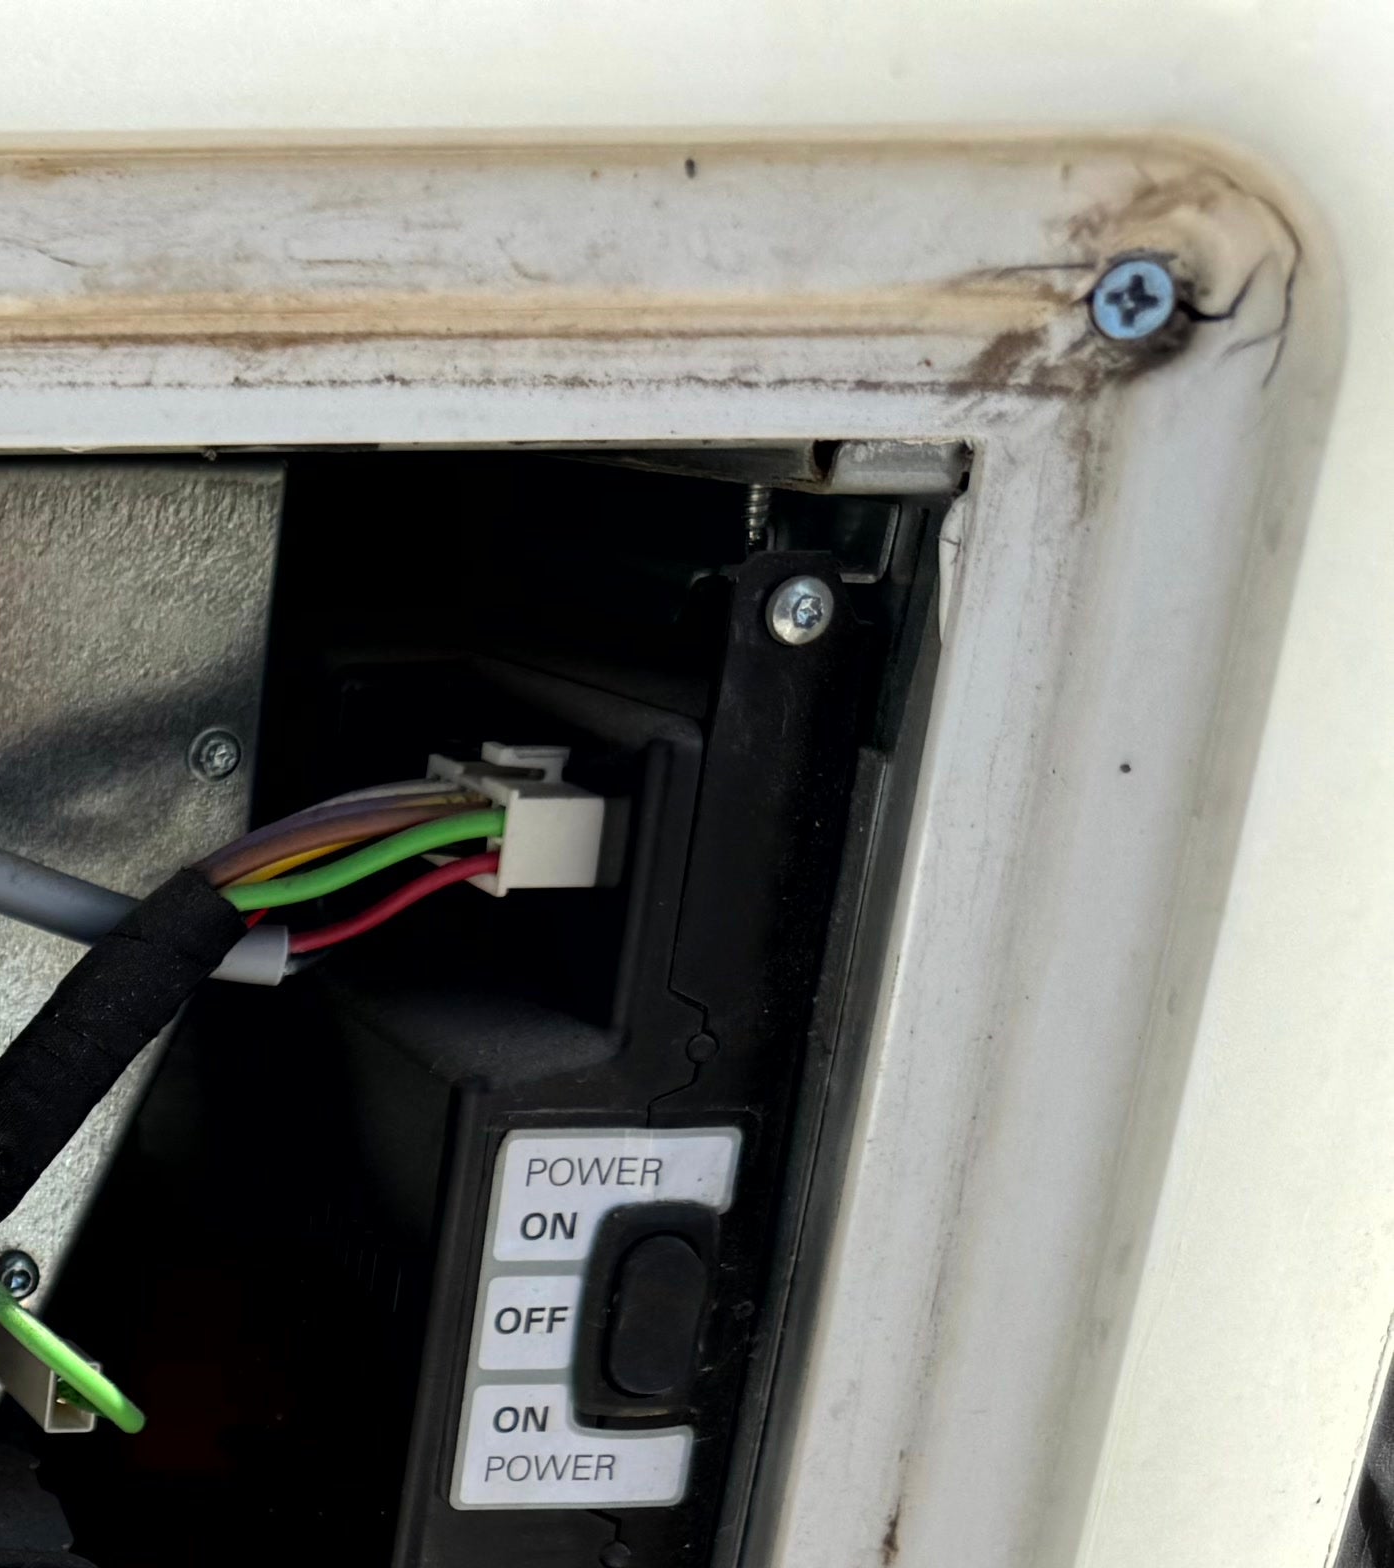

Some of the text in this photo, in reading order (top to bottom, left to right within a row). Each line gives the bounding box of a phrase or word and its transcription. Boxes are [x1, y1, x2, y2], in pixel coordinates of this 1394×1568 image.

[525, 1158, 662, 1186] POWER
[520, 1212, 577, 1240] ON
[494, 1307, 568, 1334] OFF
[493, 1406, 549, 1433] ON
[484, 1455, 615, 1482] POWER
